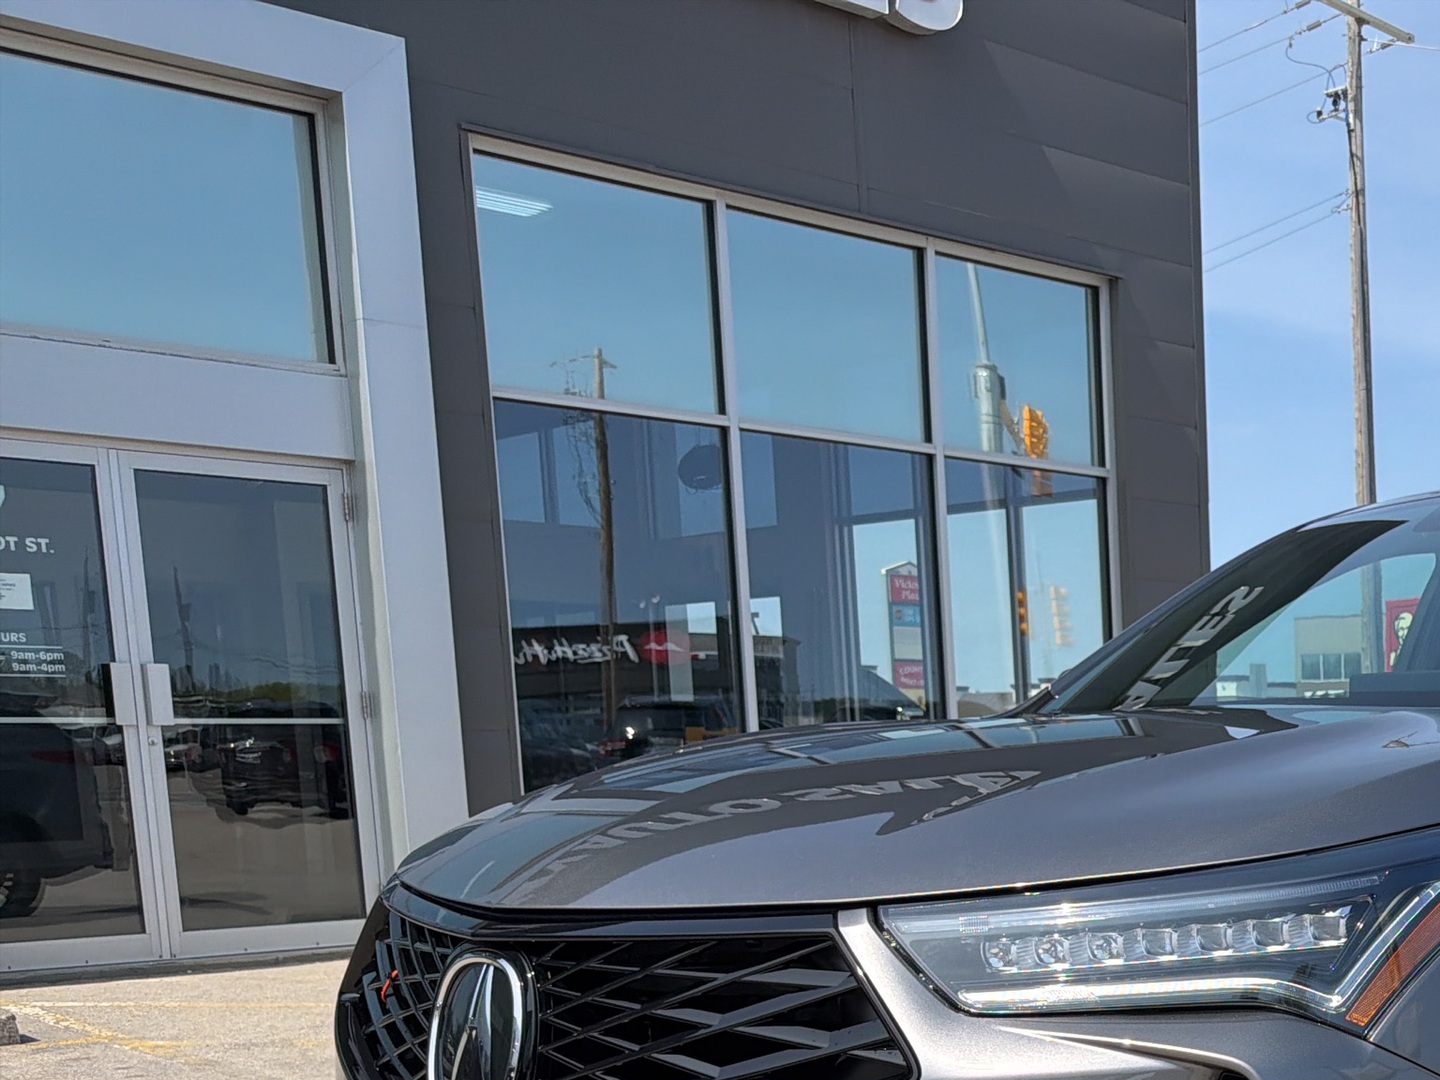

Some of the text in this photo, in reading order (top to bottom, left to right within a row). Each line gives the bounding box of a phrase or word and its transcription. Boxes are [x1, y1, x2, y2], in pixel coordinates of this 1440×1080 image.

[25, 537, 55, 553] ST.
[10, 650, 65, 662] 9am-6pm
[12, 662, 67, 673] 9am-4pm
